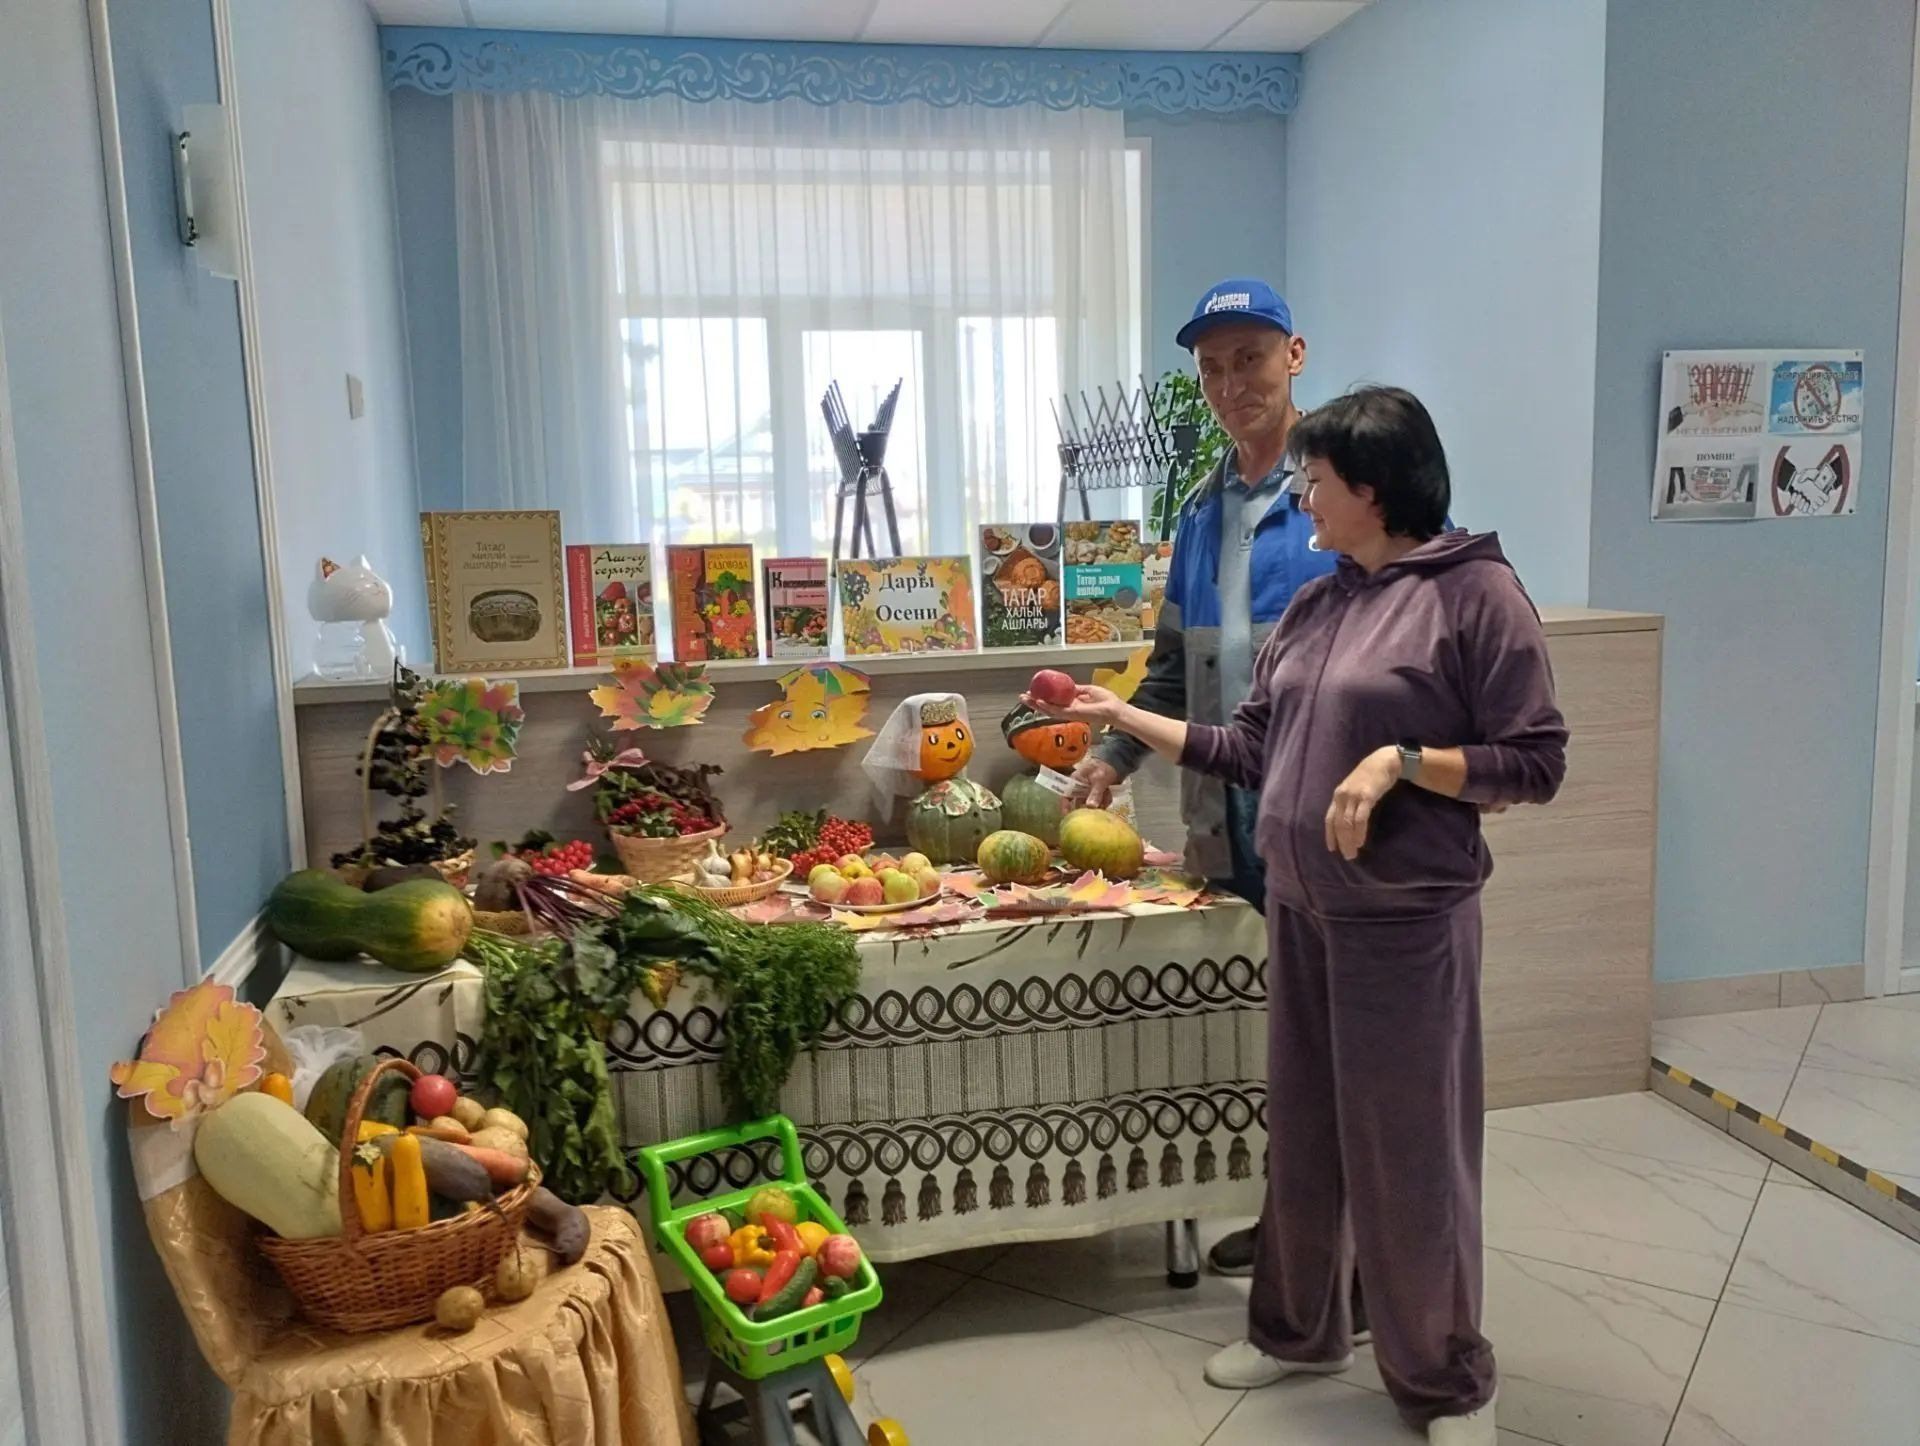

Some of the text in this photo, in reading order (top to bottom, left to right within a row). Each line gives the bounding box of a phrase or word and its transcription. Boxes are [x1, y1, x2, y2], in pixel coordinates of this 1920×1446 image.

[879, 573, 934, 593] Дары
[1000, 587, 1047, 607] ТАТАР
[876, 604, 938, 621] Осени
[1006, 606, 1043, 618] ХАЛЫК
[1001, 617, 1048, 630] АШЛАРЫ
